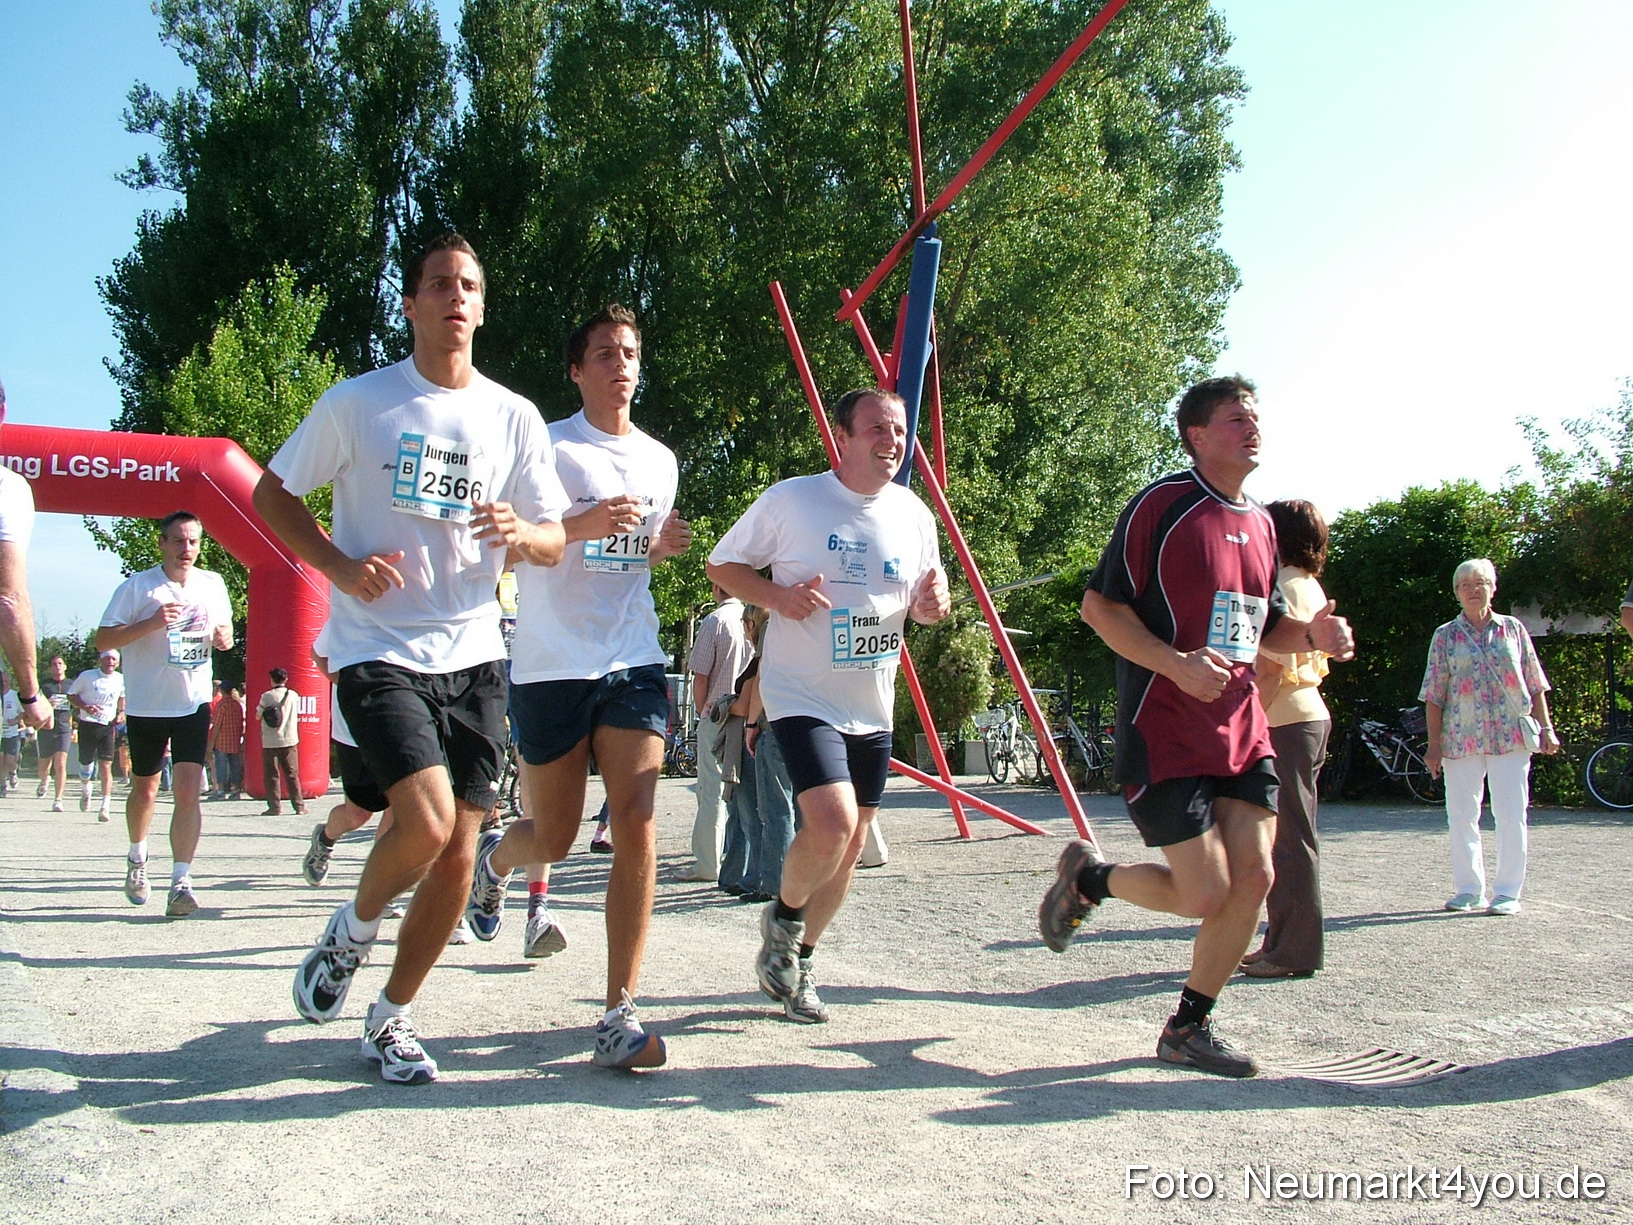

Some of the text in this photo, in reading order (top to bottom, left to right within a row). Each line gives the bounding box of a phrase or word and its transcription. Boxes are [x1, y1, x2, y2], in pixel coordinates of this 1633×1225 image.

[425, 444, 468, 466] Jürgen
[51, 454, 181, 482] LGS-Park
[403, 462, 413, 475] B
[422, 471, 482, 502] 2566
[605, 534, 650, 555] 2119
[852, 616, 880, 627] Franz
[1214, 617, 1224, 627] C
[837, 634, 847, 645] C
[855, 632, 899, 656] 2056
[182, 648, 208, 660] 2314
